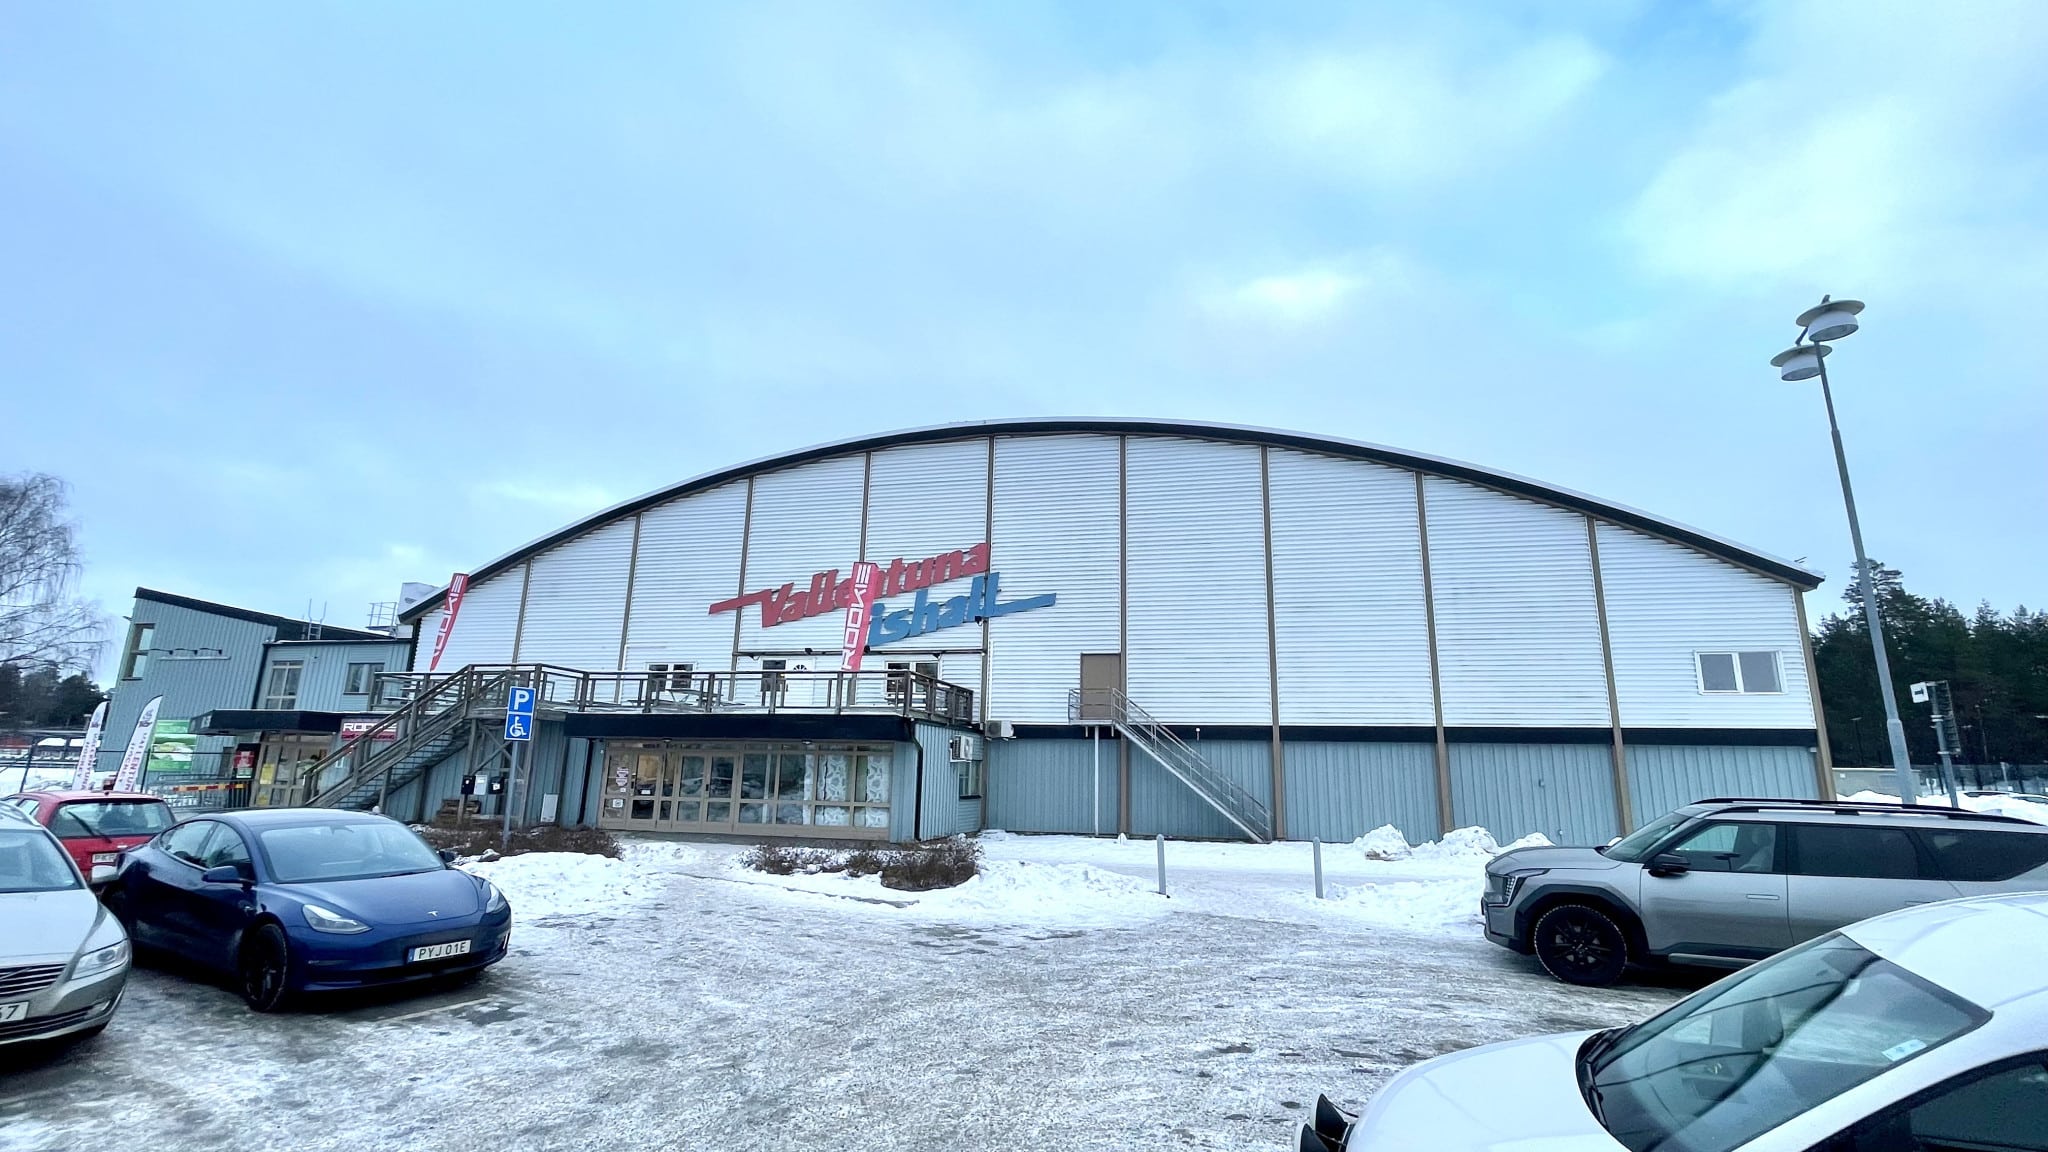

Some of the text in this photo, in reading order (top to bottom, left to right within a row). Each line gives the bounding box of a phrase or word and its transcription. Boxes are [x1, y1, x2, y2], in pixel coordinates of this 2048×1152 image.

[841, 565, 871, 669] ROOKIE
[868, 571, 1056, 646] ishall
[514, 690, 530, 710] P
[419, 942, 466, 959] PYJ 01E
